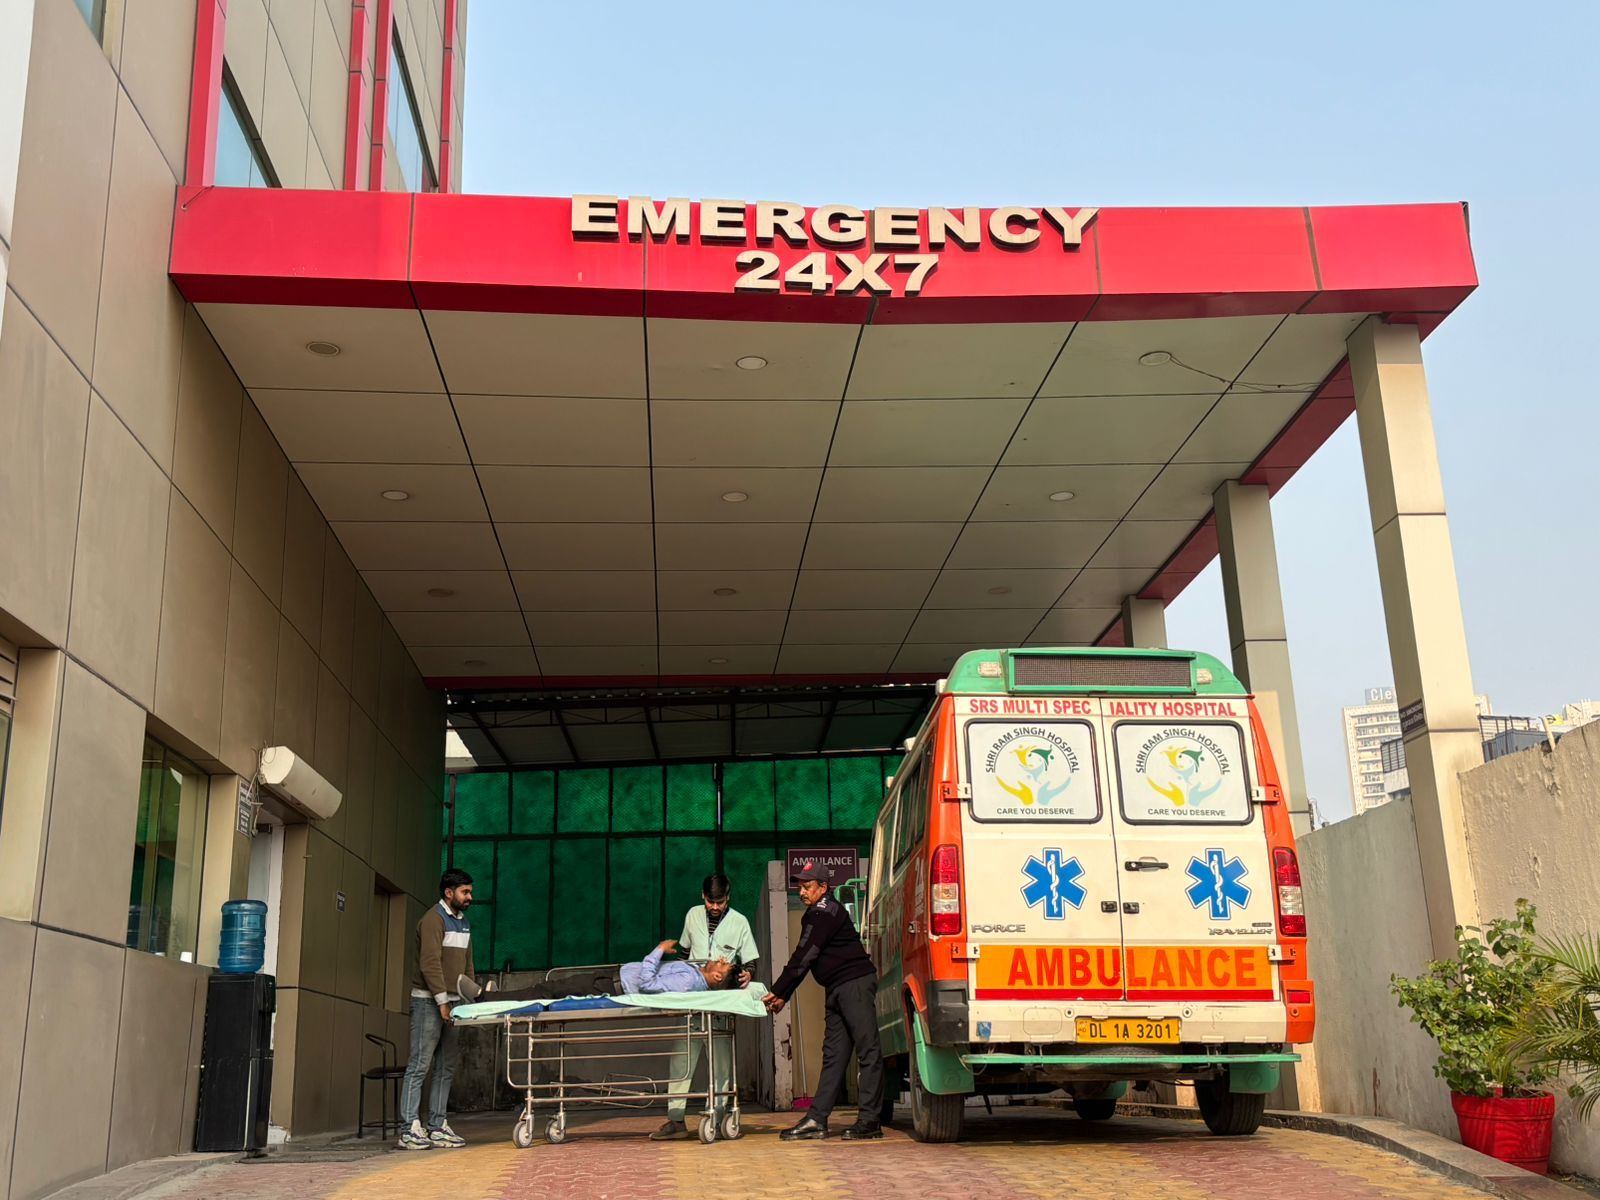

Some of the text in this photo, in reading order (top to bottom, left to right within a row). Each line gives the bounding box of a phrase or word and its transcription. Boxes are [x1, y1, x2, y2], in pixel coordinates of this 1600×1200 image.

[572, 194, 1099, 250] EMERGENCY
[734, 250, 939, 297] 24X7
[970, 699, 1236, 716] SRS MULTI SPEC IALITY HOSPITAL
[1371, 688, 1396, 700] Cle
[985, 727, 1080, 773] SHRI RAM SINGH HOSPITAL
[1136, 728, 1231, 775] SHRI RAM SINGH HOSPITAL
[1147, 808, 1169, 816] CARE
[1189, 809, 1226, 817] DESERVE
[971, 924, 1026, 933] FORCE
[1007, 948, 1257, 987] AMBULANCE
[1089, 1023, 1171, 1039] DL 1A 3201
